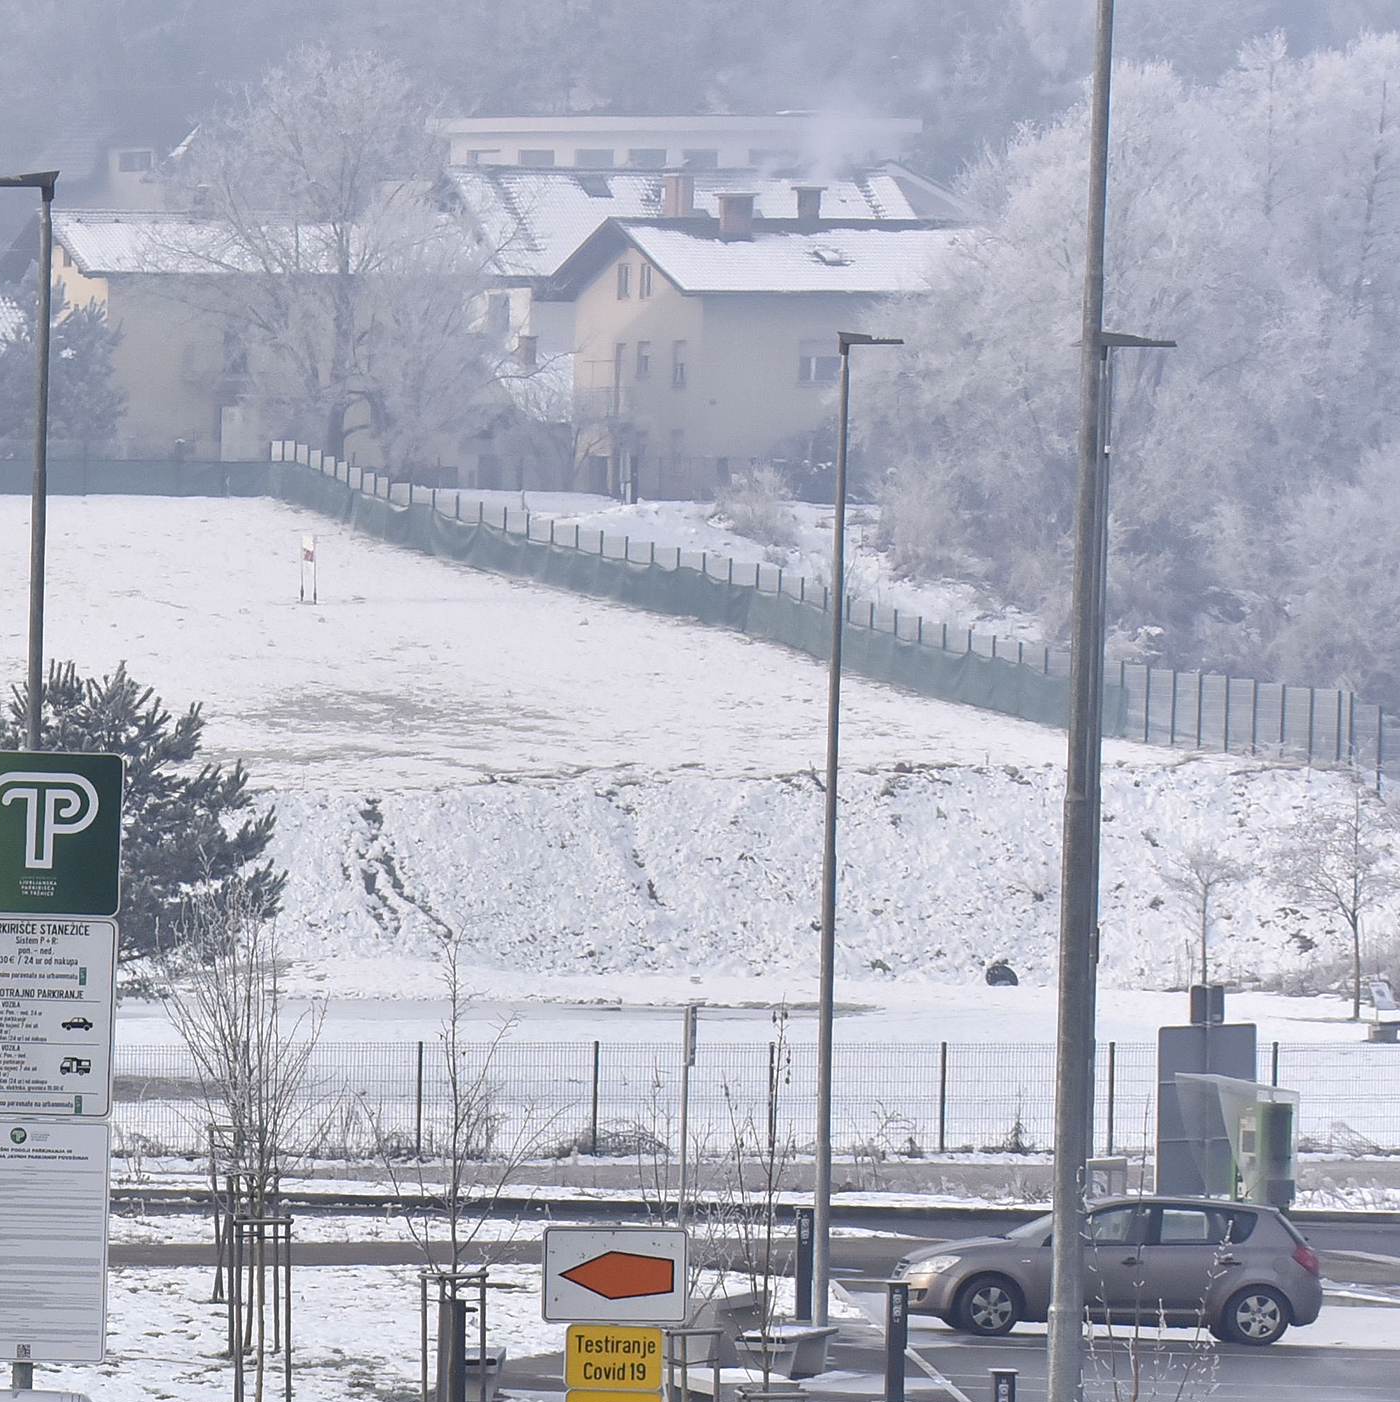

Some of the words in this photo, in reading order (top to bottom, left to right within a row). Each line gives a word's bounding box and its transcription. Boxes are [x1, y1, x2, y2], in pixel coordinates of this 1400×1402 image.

[40, 922, 90, 936] STANEŽIČE
[15, 936, 39, 945] Sistem
[40, 937, 45, 945] P
[24, 956, 34, 965] 24
[44, 957, 52, 965] od
[54, 957, 78, 967] nakupa
[37, 989, 84, 999] PARKIRANJE
[575, 1334, 656, 1358] Testiranje
[583, 1362, 626, 1381] Covid
[631, 1363, 646, 1381] 19
